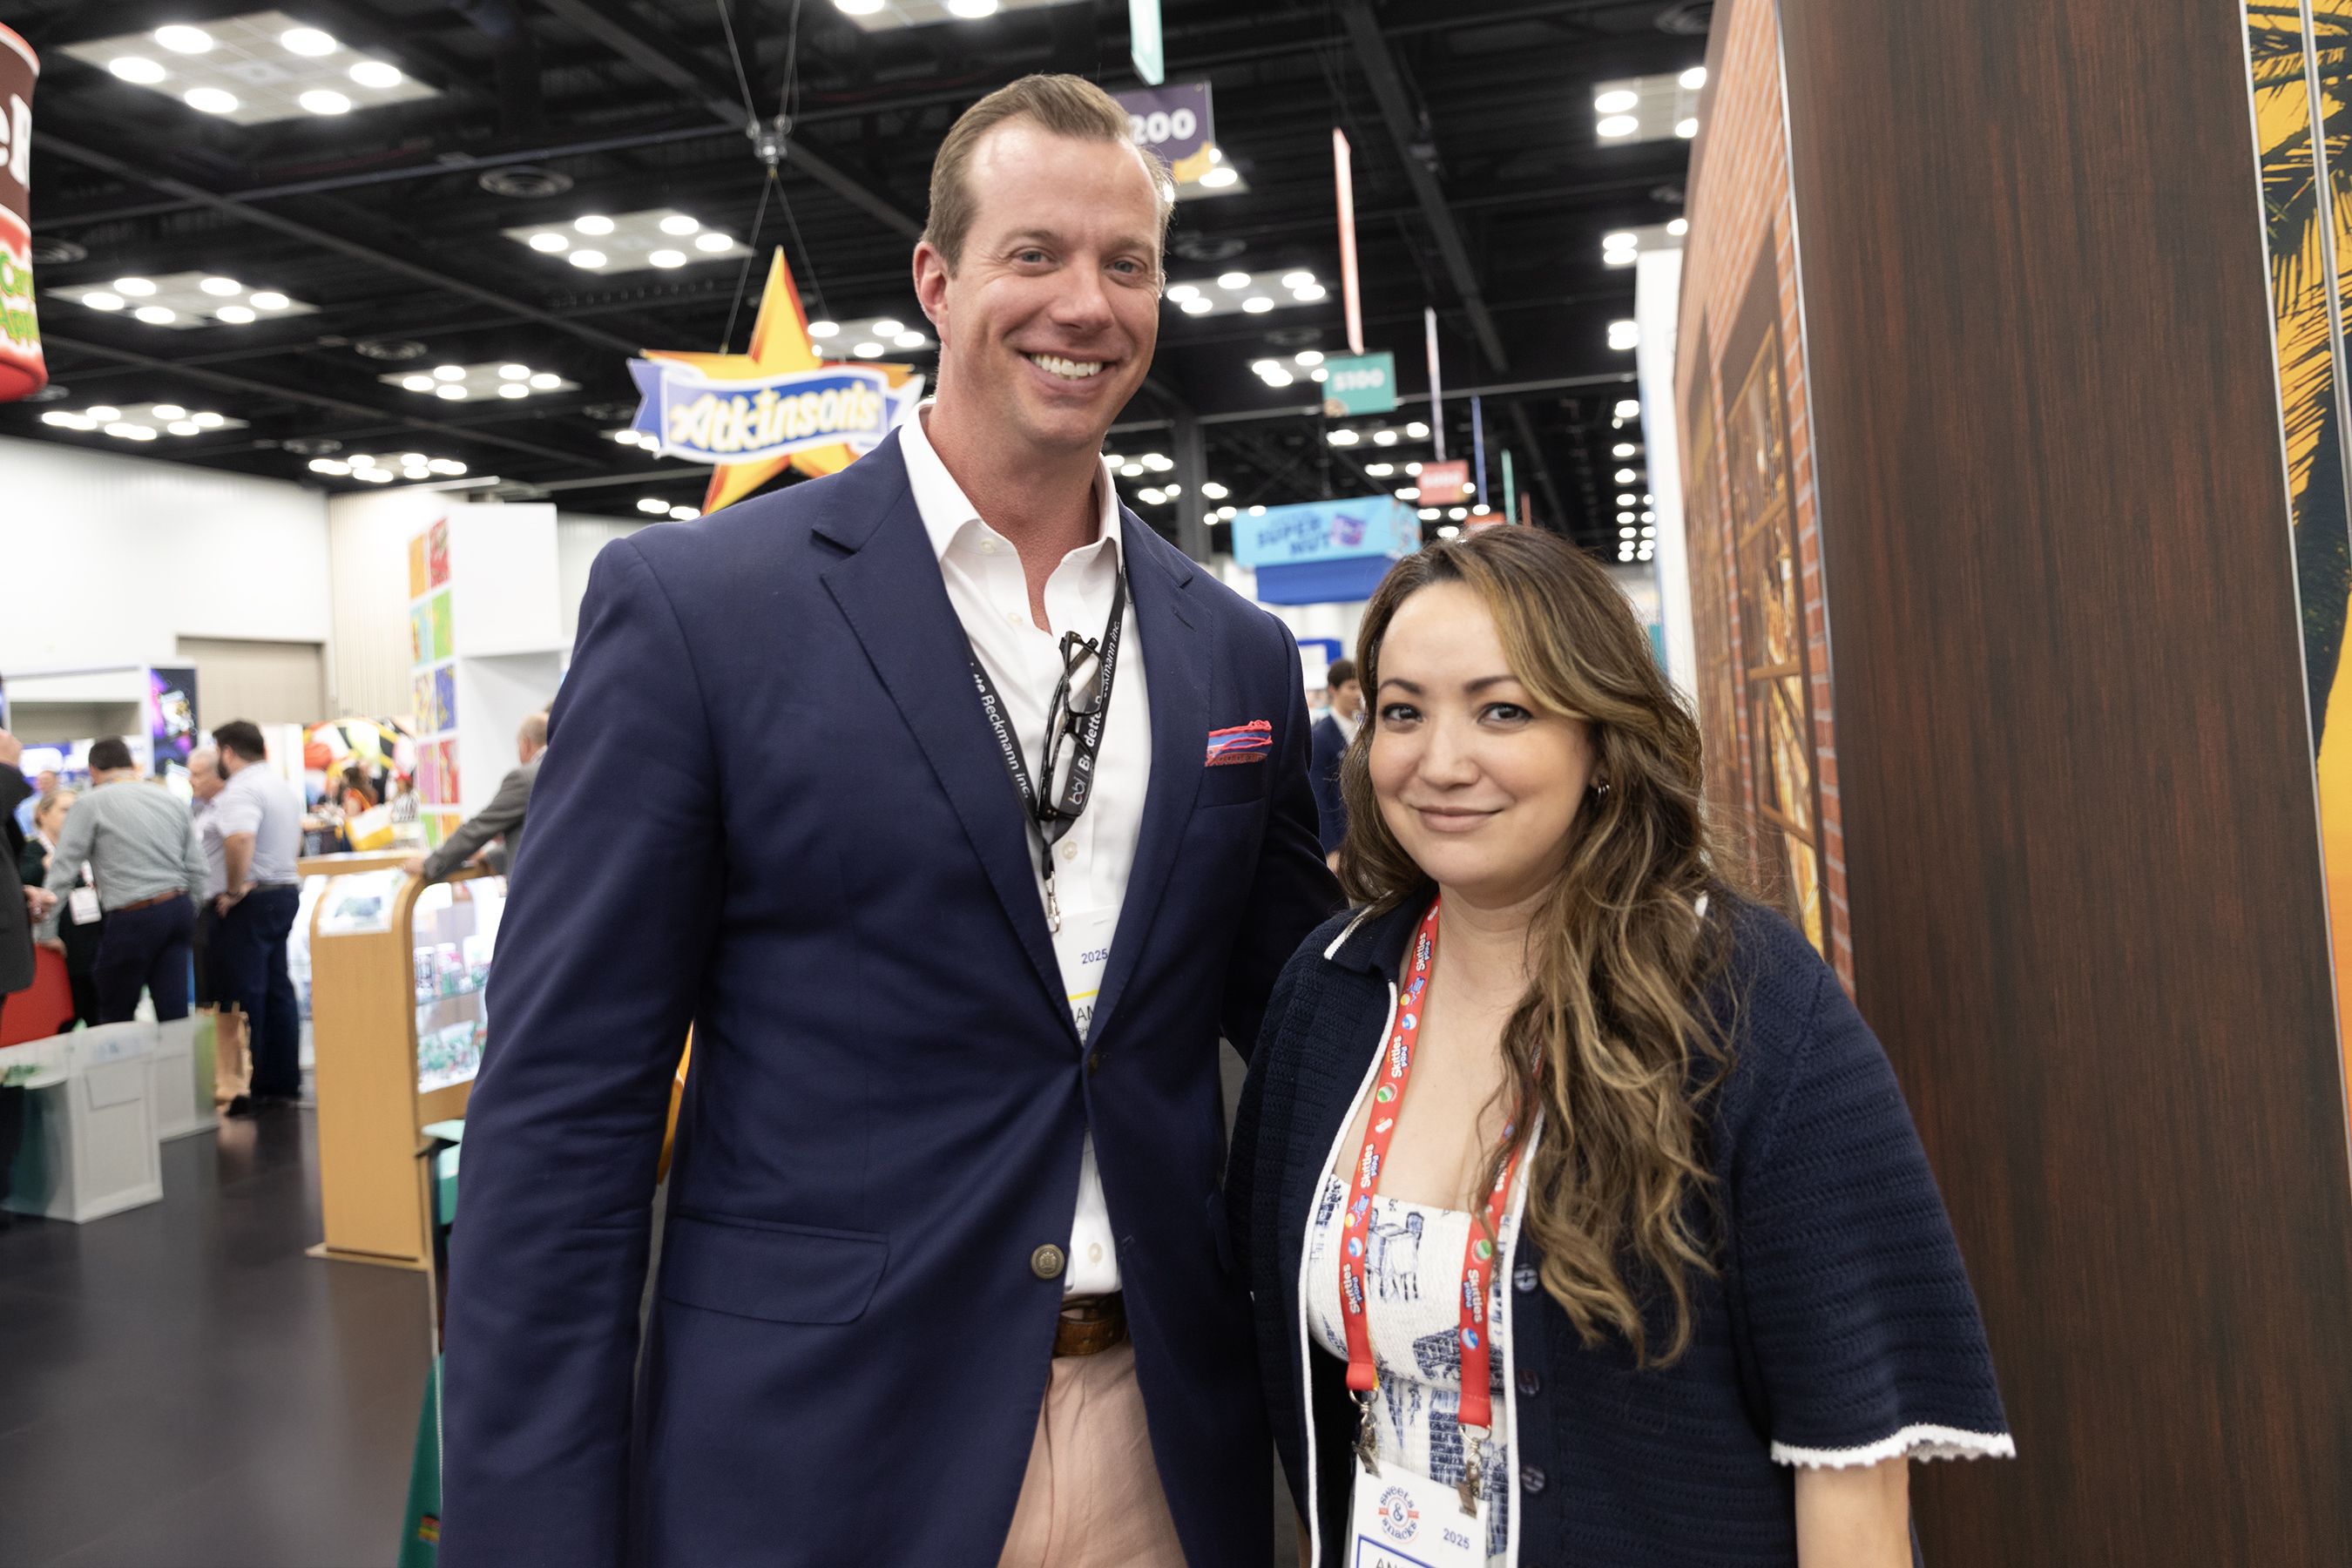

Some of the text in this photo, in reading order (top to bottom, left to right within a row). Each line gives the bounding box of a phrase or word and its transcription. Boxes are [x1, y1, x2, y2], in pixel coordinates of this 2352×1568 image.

[669, 381, 882, 452] Atkinson's
[981, 694, 1031, 798] Beckmann inc.
[1081, 949, 1109, 964] 2025
[1416, 931, 1427, 971] Skittles
[1391, 1035, 1402, 1078] Skittles
[1361, 1144, 1375, 1189] Skittles
[1343, 1263, 1361, 1315] Skittles
[1467, 1269, 1483, 1323] Skittles
[1380, 1486, 1415, 1509] sweets
[1382, 1517, 1417, 1540] snacks
[1443, 1527, 1470, 1550] 2025
